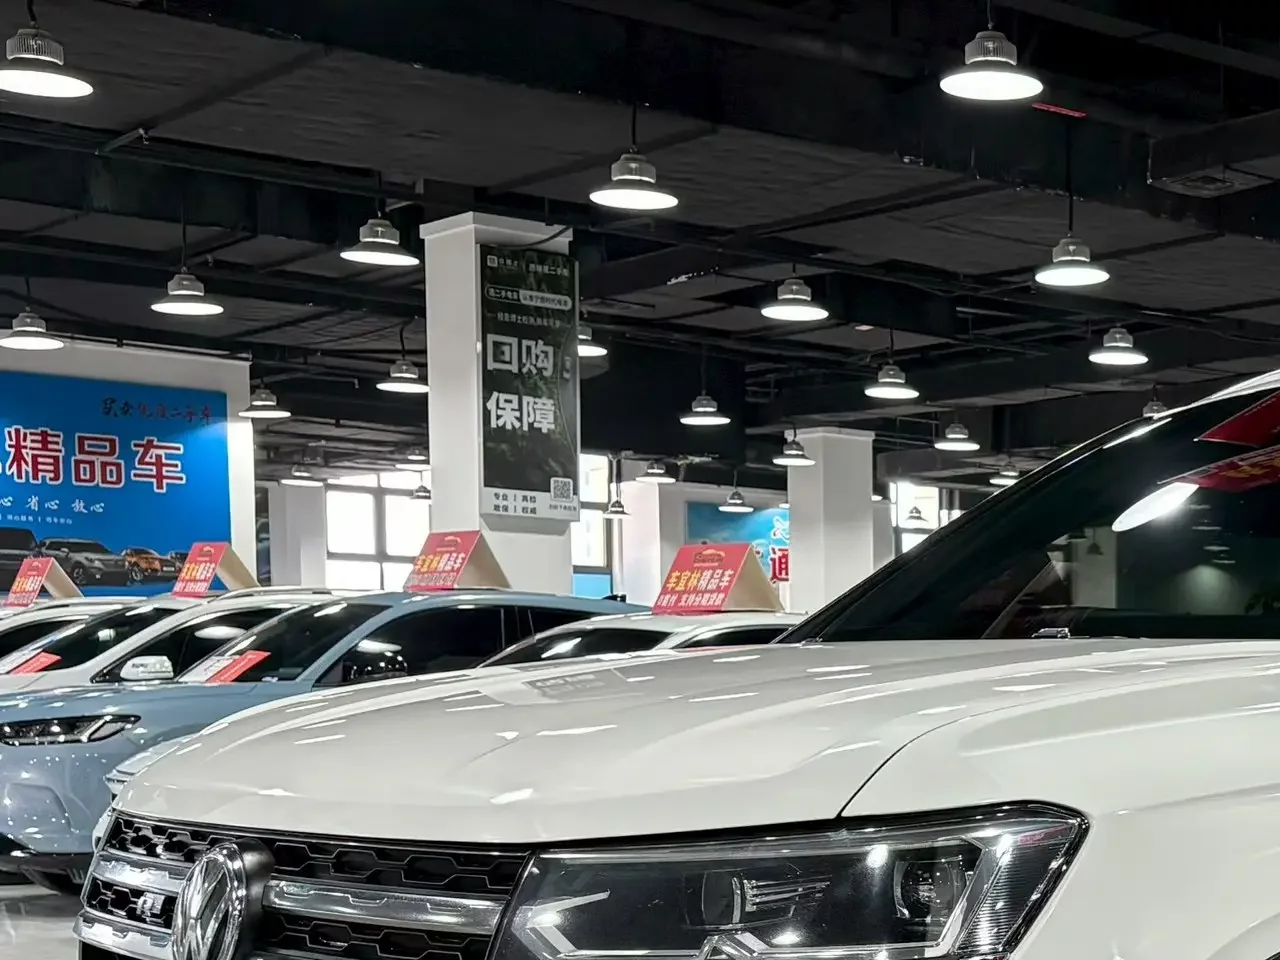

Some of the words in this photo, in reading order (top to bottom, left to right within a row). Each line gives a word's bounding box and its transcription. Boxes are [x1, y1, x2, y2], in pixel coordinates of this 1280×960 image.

[486, 333, 554, 378] 回购
[486, 391, 555, 433] 保障
[666, 568, 734, 592] 车宜林精品车
